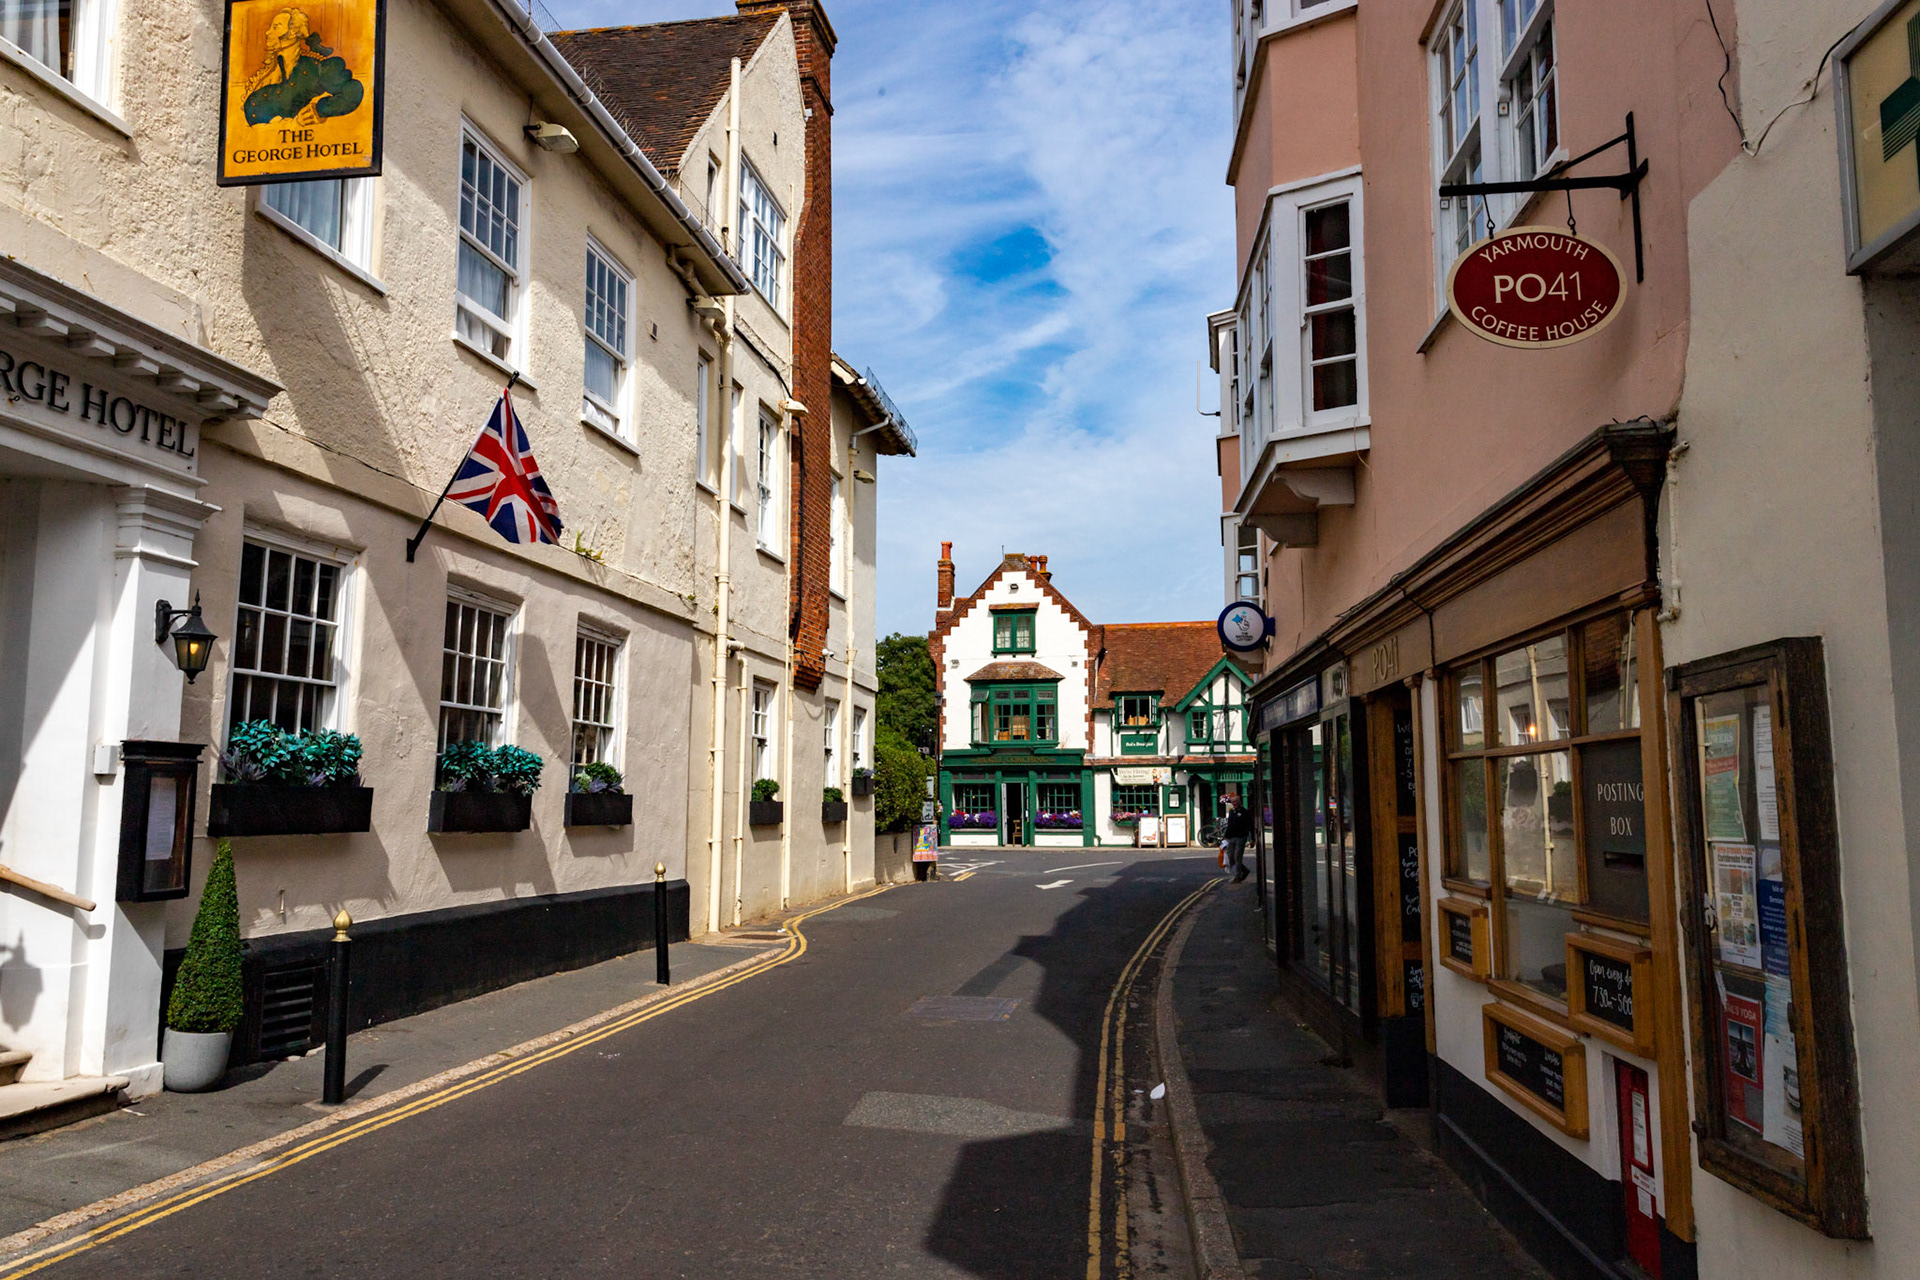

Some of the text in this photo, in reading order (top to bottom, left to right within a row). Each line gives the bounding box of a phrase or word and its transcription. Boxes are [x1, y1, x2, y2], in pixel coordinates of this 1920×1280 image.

[278, 129, 314, 143] THE
[233, 142, 363, 164] GEORGE HOTEL
[1479, 234, 1589, 263] YARMOUTH
[1493, 271, 1582, 304] PO41
[1471, 300, 1608, 341] COFFEE HOUSE
[81, 383, 195, 457] HOTEL
[1372, 635, 1400, 684] PO41
[1597, 782, 1644, 802] POSTING
[1610, 816, 1633, 837] BOX
[1589, 959, 1606, 982] Open
